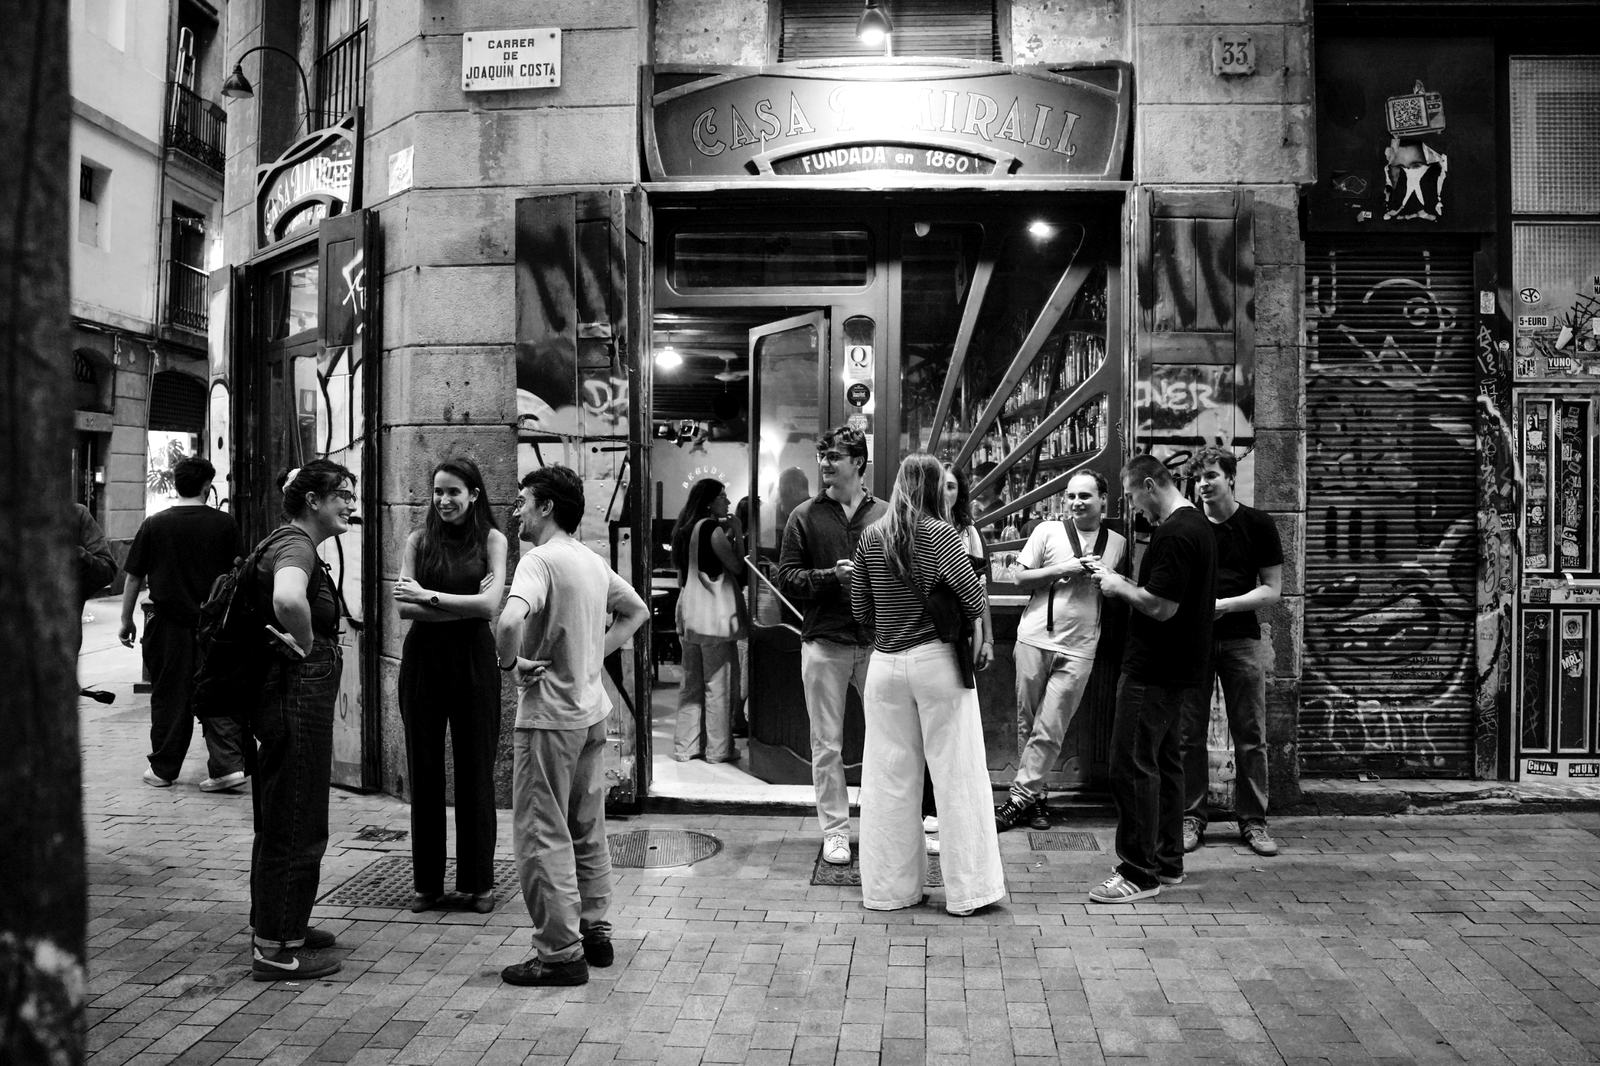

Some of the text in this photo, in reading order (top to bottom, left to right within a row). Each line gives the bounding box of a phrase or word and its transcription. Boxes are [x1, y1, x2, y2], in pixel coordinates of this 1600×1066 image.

[488, 38, 535, 49] CARRER
[503, 51, 518, 60] DE
[1222, 42, 1248, 65] 33
[520, 63, 555, 77] COSTA
[692, 91, 816, 156] CASA
[802, 147, 969, 173] FUNDADA en 1860
[1519, 316, 1547, 326] 5-EURO
[850, 347, 868, 368] Q
[1548, 357, 1571, 367] YUNO
